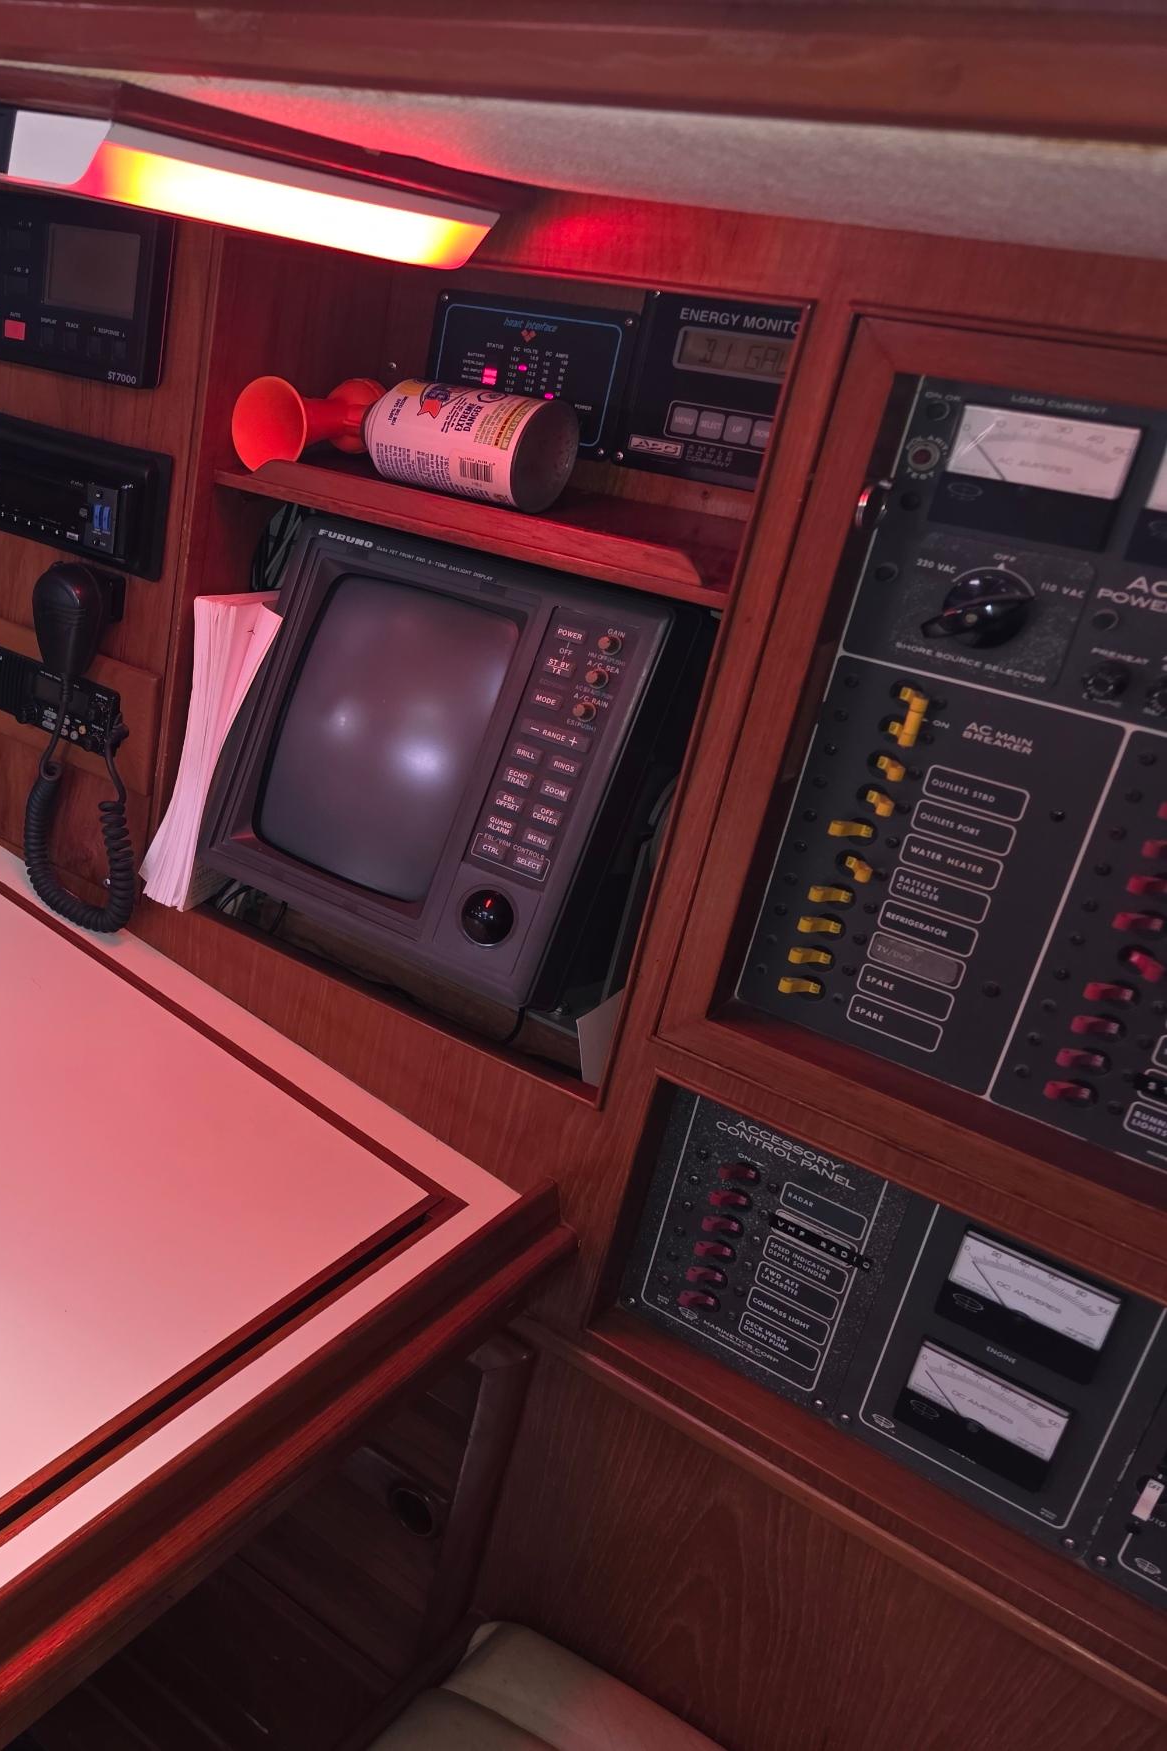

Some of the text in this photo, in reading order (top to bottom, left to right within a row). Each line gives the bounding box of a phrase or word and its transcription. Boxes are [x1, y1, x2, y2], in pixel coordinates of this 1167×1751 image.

[40, 317, 57, 325] DISPLAY
[679, 307, 741, 327] ENERGY
[486, 342, 504, 350] STATUS
[574, 403, 592, 411] POWER
[1011, 395, 1108, 414] LOAD CURRENT
[454, 403, 477, 432] EXTREME
[463, 406, 484, 432] DANGER
[675, 415, 693, 425] MENU
[701, 420, 721, 430] SELECT
[685, 455, 731, 468] COMPANY
[318, 528, 374, 548] FURUNO
[399, 552, 414, 560] FRONT
[448, 564, 472, 576] DAYLIGHT
[473, 571, 493, 581] DISPLAY
[993, 553, 1016, 562] OFF
[916, 558, 956, 574] 220 VAC
[1040, 582, 1086, 598] 110 VAC
[557, 628, 583, 640] POWER
[607, 628, 626, 639] GAIN
[559, 647, 573, 656] OFF
[1091, 647, 1149, 665] PREHEAT
[548, 658, 570, 669] ST BY
[586, 660, 620, 675] A/C SEA
[895, 641, 1046, 683] SHORE SOURCE SELECTOR
[552, 667, 561, 676] TX
[535, 694, 557, 706] MODE
[573, 692, 589, 703] A/C
[592, 698, 609, 708] RAIN
[933, 720, 950, 729] ON
[542, 729, 566, 742] RANGE
[962, 730, 1033, 755] BREAKER
[966, 722, 1033, 747] AC MAIN
[516, 748, 535, 760] BRILL
[508, 769, 528, 780] ECHO
[553, 761, 575, 773] RINGS
[507, 775, 526, 787] TRAIL
[503, 794, 515, 804] EBL
[544, 785, 566, 797] ZOOM
[931, 779, 995, 803] OUTLETS STBD
[495, 799, 520, 812] OFFSET
[540, 807, 554, 817] OFF
[489, 816, 512, 829] GUARD
[532, 812, 558, 826] CENTER
[920, 812, 980, 836] OUTLETS PORT
[487, 823, 510, 836] ALARM
[527, 833, 547, 846] MENU
[482, 844, 500, 856] CTRL
[513, 844, 545, 860] CONTROLS
[516, 856, 541, 871] SELECT
[910, 845, 984, 875] WATER HEATER
[896, 882, 940, 902] CHARGER
[898, 875, 939, 893] BATTERY
[885, 911, 948, 938] REFRIGERATOR
[865, 975, 895, 991] SPARE
[855, 1006, 884, 1022] SPARE
[736, 1120, 841, 1171] ACCESSORY
[716, 1121, 856, 1191] CONTROL PANEL
[737, 1152, 751, 1162] ON
[787, 1192, 815, 1208] RADAR
[777, 1220, 870, 1269] VHF RADIO
[770, 1242, 831, 1275] SPEED INDICATOR
[991, 1250, 1002, 1259] 20
[768, 1248, 827, 1281] DEPTH SOUNDER
[761, 1273, 798, 1296] LAZARETTE
[764, 1267, 800, 1289] FWD AFT
[996, 1280, 1011, 1291] DC
[1013, 1289, 1062, 1314] AMPERES
[752, 1297, 810, 1330] COMPASS LIGHT
[1098, 1306, 1112, 1316] 100
[703, 1319, 753, 1350] MARINETICS
[743, 1324, 768, 1342] DOWN
[768, 1337, 789, 1352] PUMP
[745, 1319, 764, 1332] DECK
[765, 1329, 787, 1345] WASH
[986, 1345, 1017, 1365] ENGINE
[951, 1390, 1014, 1425] DC AMPERES
